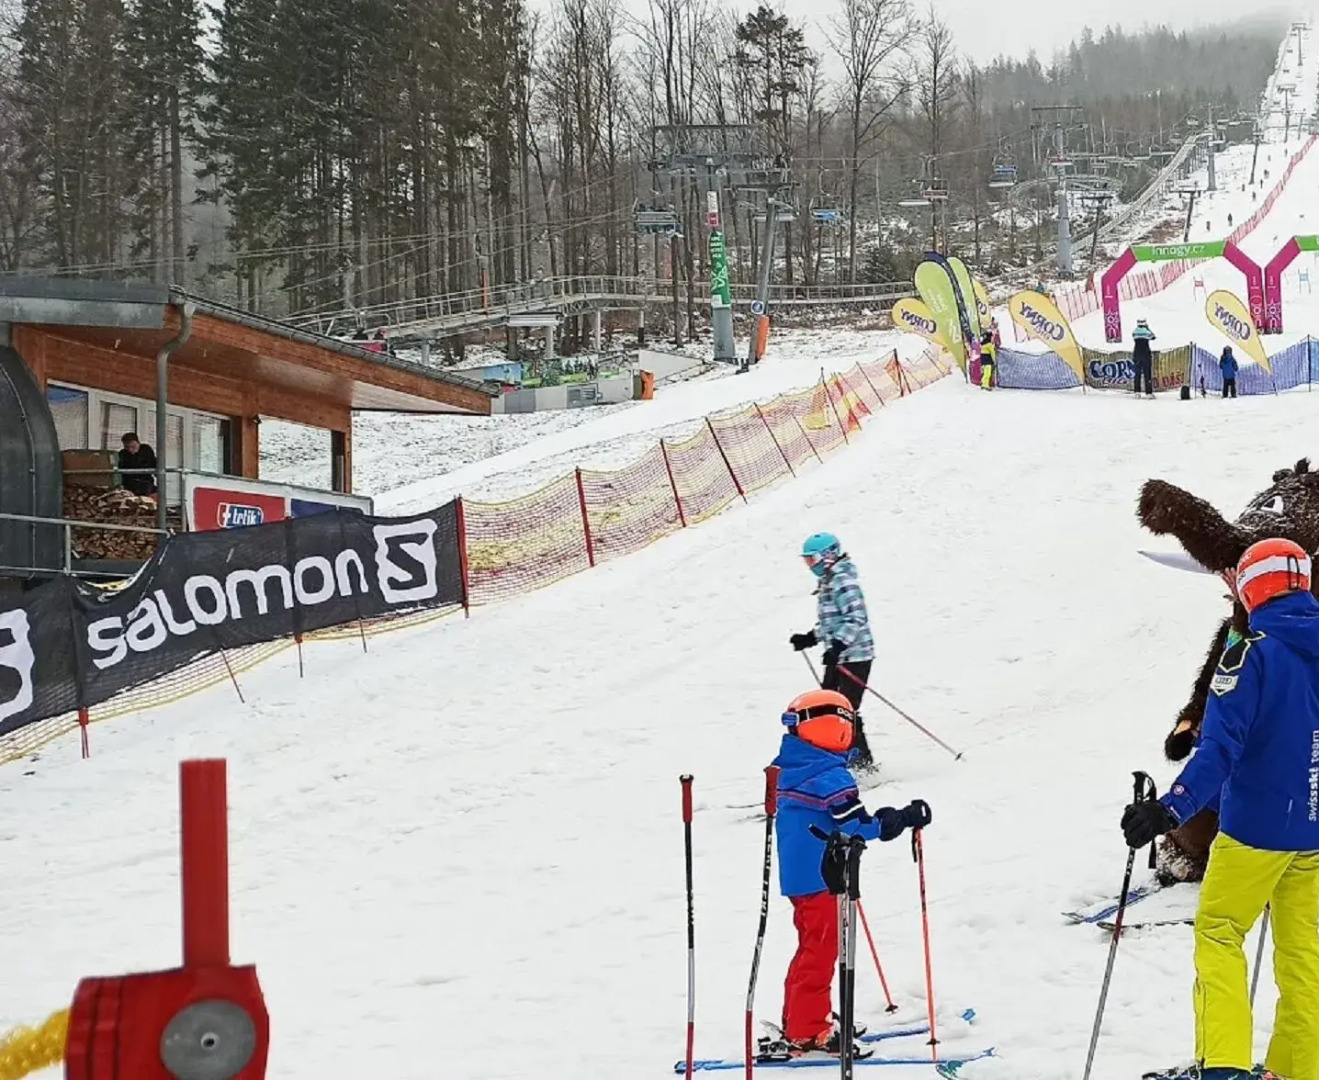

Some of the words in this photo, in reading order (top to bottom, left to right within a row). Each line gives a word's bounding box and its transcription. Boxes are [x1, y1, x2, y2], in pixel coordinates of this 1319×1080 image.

[1152, 244, 1206, 257] innogy.cz
[1088, 358, 1136, 380] CORN
[1311, 730, 1319, 763] team
